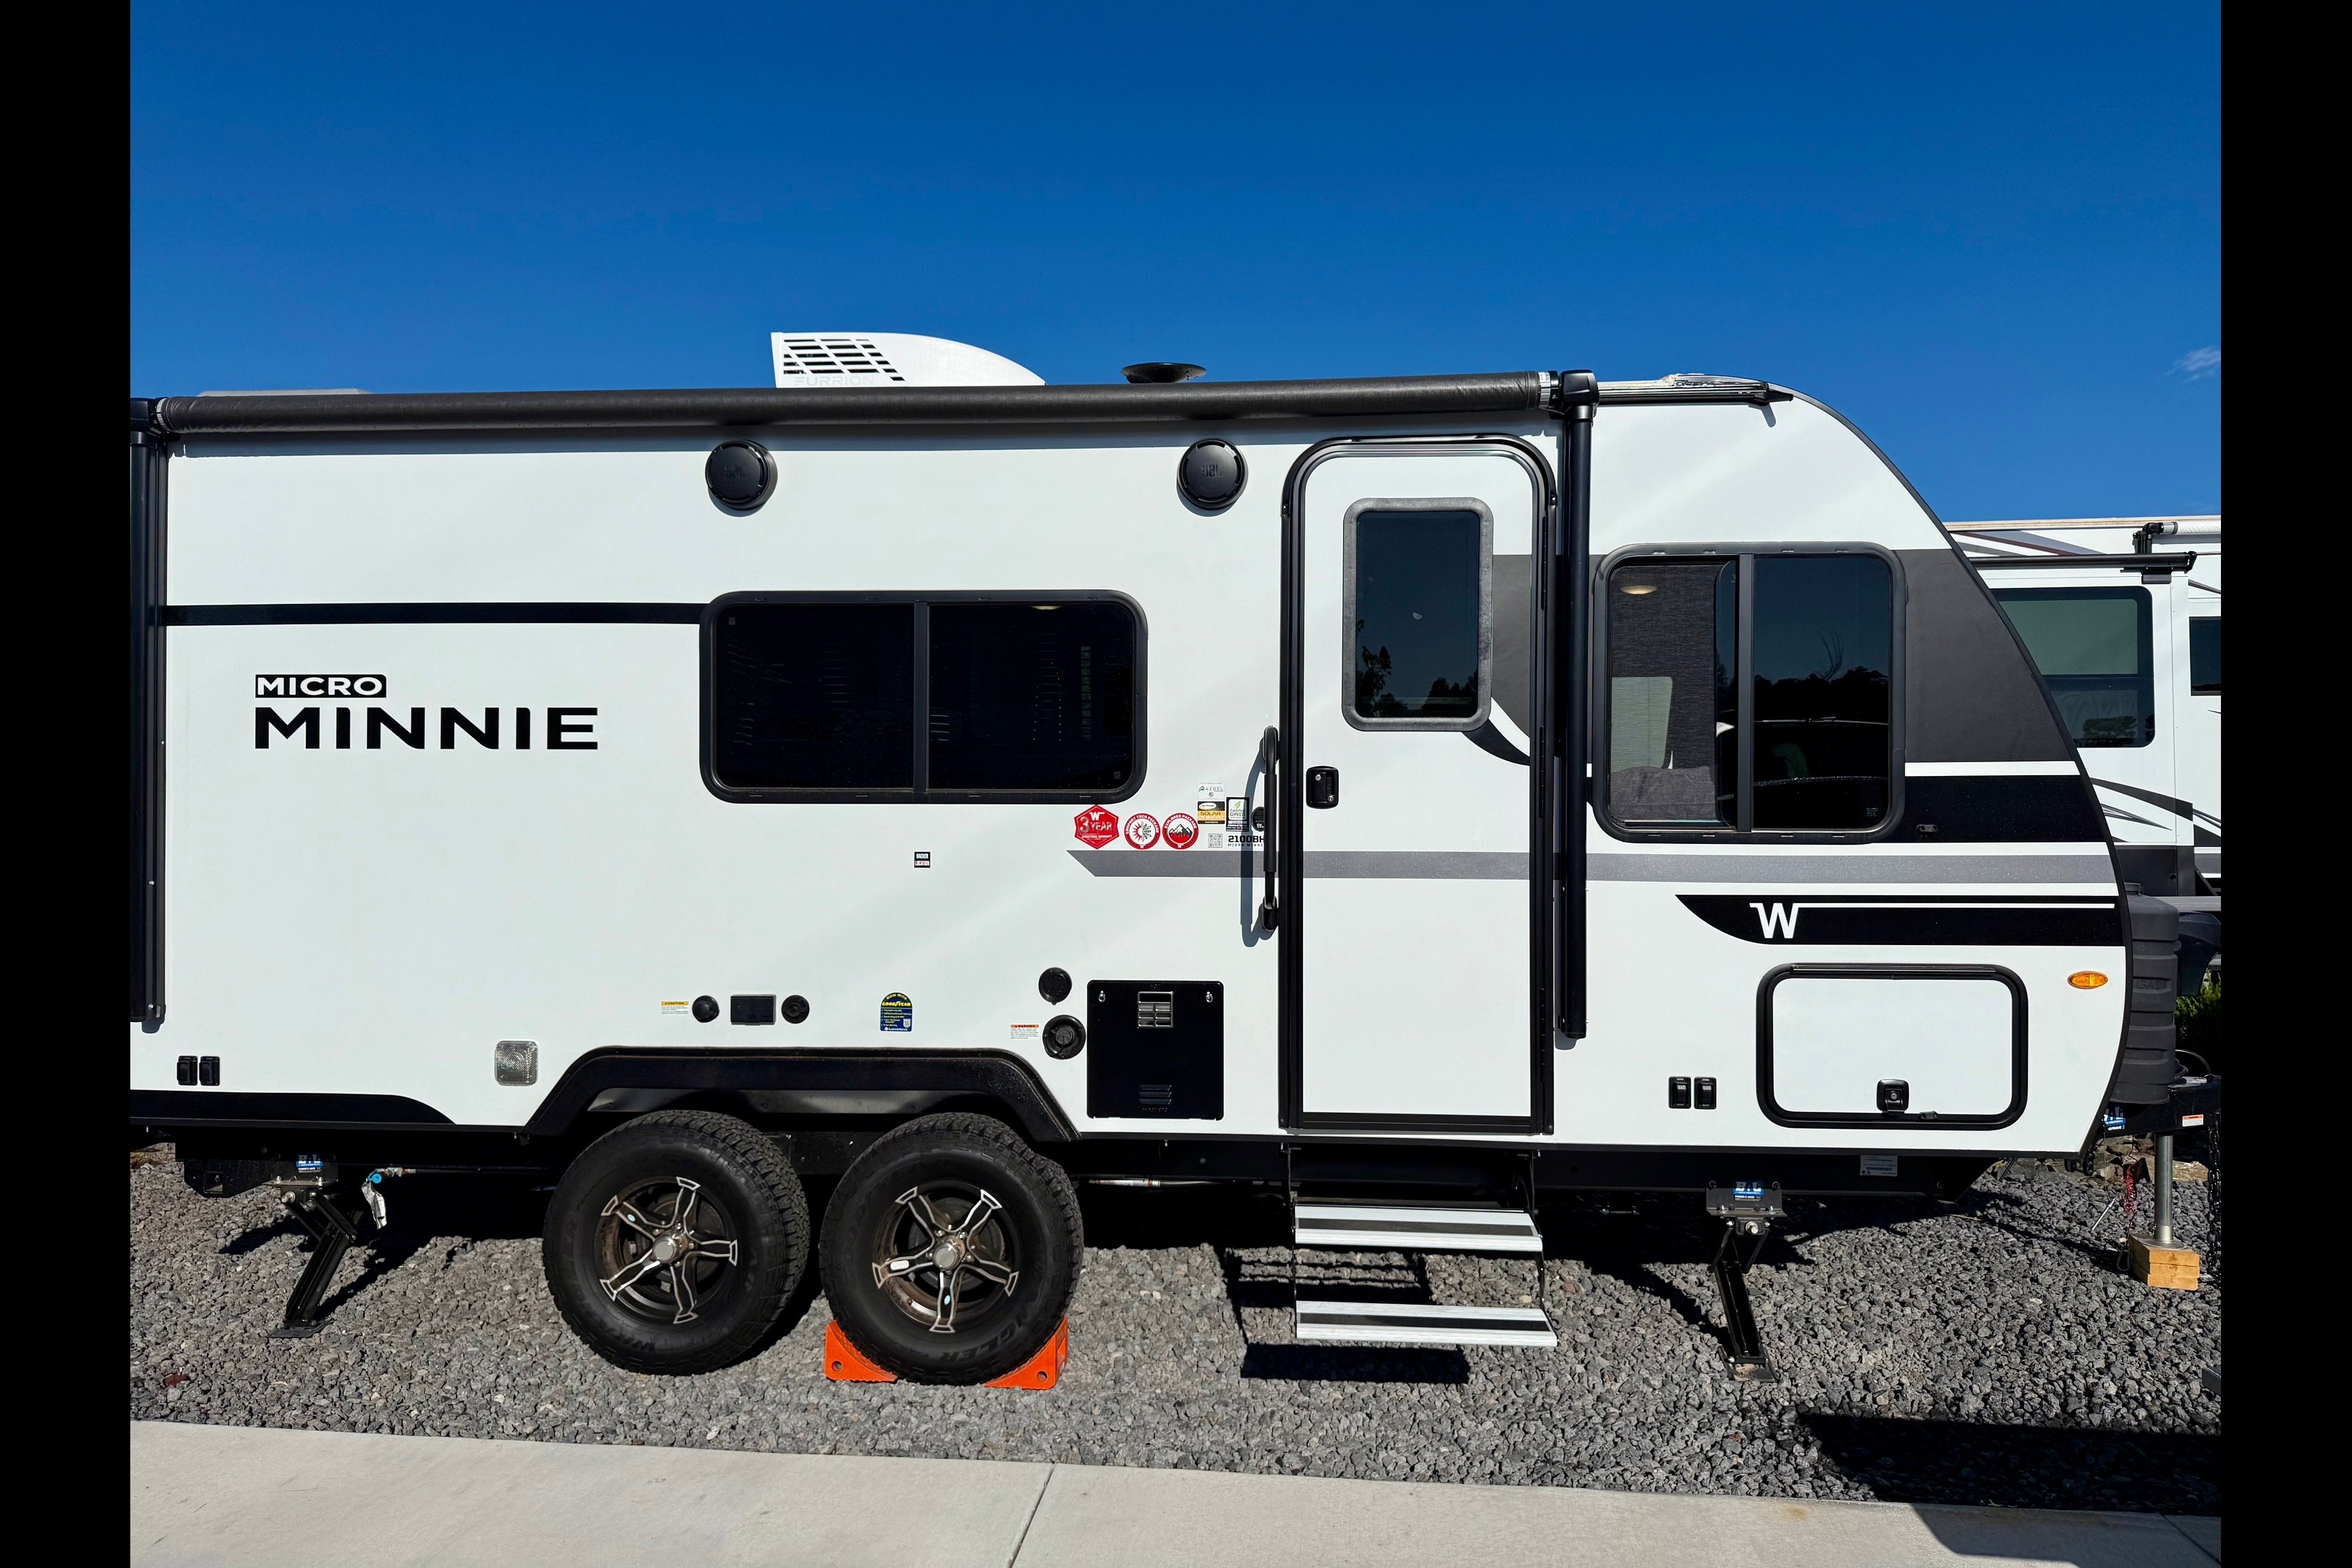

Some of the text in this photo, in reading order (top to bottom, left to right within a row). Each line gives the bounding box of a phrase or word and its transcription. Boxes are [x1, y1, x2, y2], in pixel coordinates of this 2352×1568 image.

[794, 376, 874, 386] FURRION
[1201, 464, 1222, 477] JBL
[257, 676, 383, 695] MICRO
[255, 707, 598, 750] MINNIE
[1080, 816, 1112, 833] 3 YEAR
[1125, 817, 1136, 834] COMFORT
[1147, 815, 1159, 833] PACKAGE
[1164, 814, 1197, 829] EXPLORER PACKAGE
